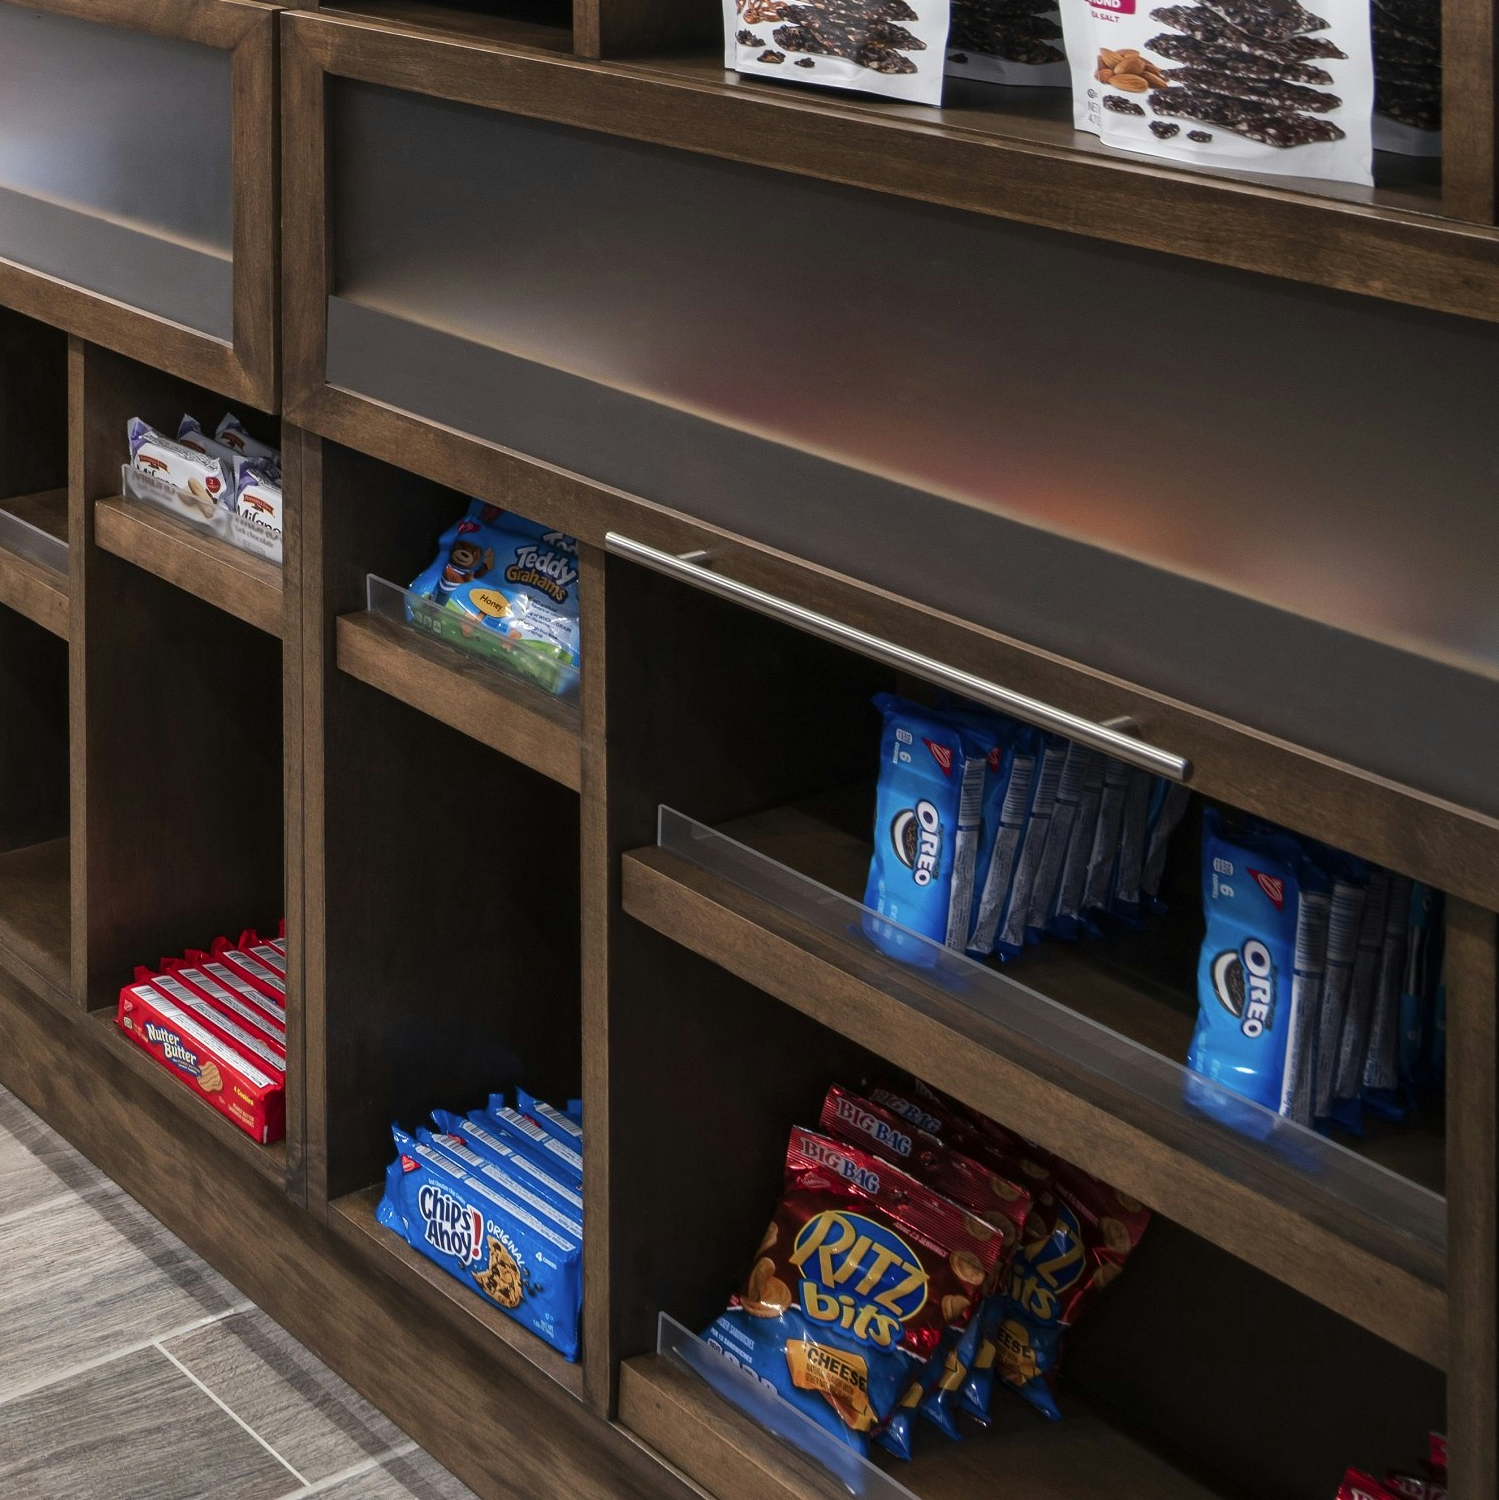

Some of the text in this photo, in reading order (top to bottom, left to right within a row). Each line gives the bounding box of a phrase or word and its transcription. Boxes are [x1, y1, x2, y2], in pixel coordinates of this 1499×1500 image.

[1100, 13, 1120, 23] SALT
[505, 565, 566, 602] Grahams
[516, 546, 577, 586] Teddy
[479, 594, 504, 612] Honey
[899, 751, 912, 764] 6
[914, 800, 940, 887] OREO
[1220, 883, 1235, 898] 6
[1242, 939, 1272, 1039] OREO
[146, 1023, 180, 1046] Nutter
[164, 1042, 197, 1065] Butter
[837, 1097, 913, 1157] BIG BAG
[801, 1138, 880, 1194] BIG BAG
[420, 1186, 472, 1231] Chips
[427, 1210, 483, 1263] Ahoy!
[487, 1220, 526, 1268] ORIGINAL
[789, 1210, 929, 1317] RITZ
[802, 1280, 901, 1348] bits
[807, 1347, 868, 1391] CHEESE
